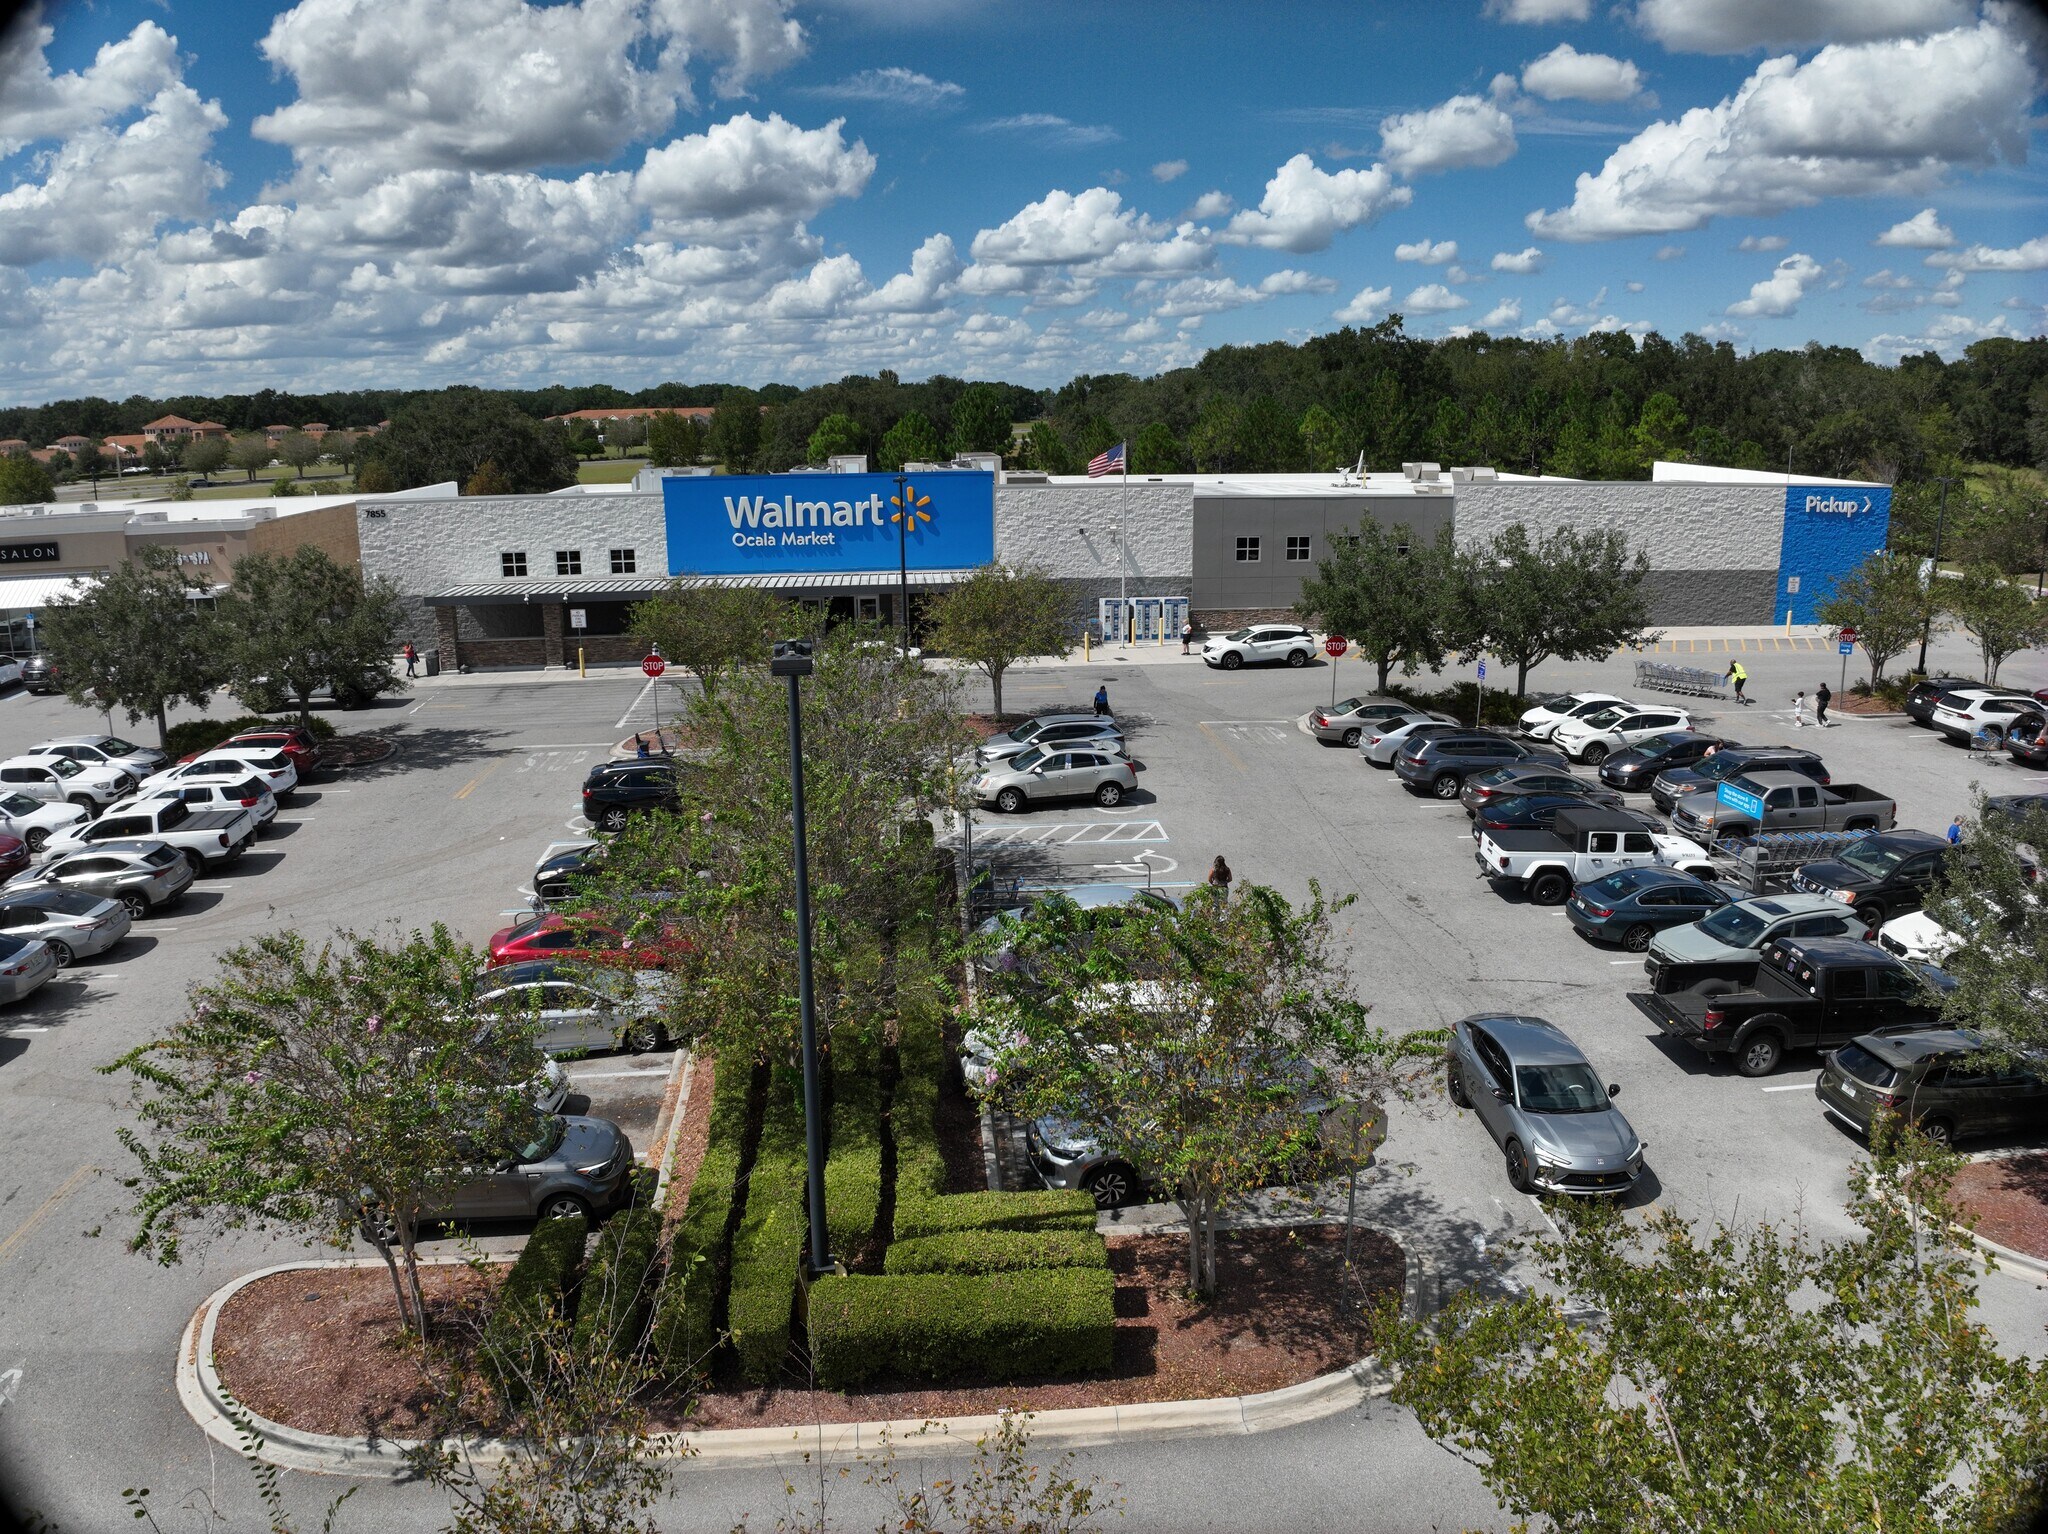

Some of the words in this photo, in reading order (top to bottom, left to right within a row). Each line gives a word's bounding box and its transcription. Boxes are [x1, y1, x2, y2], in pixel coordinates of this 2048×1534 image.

[724, 493, 884, 528] Walmart
[1805, 495, 1858, 518] Pickup
[365, 509, 386, 519] 7855
[732, 532, 776, 547] Ocala
[781, 531, 835, 546] Market
[1, 547, 55, 560] SALON
[192, 551, 210, 565] SPA
[1840, 633, 1856, 642] STOP
[1326, 641, 1346, 651] STOP
[643, 661, 663, 671] STOP
